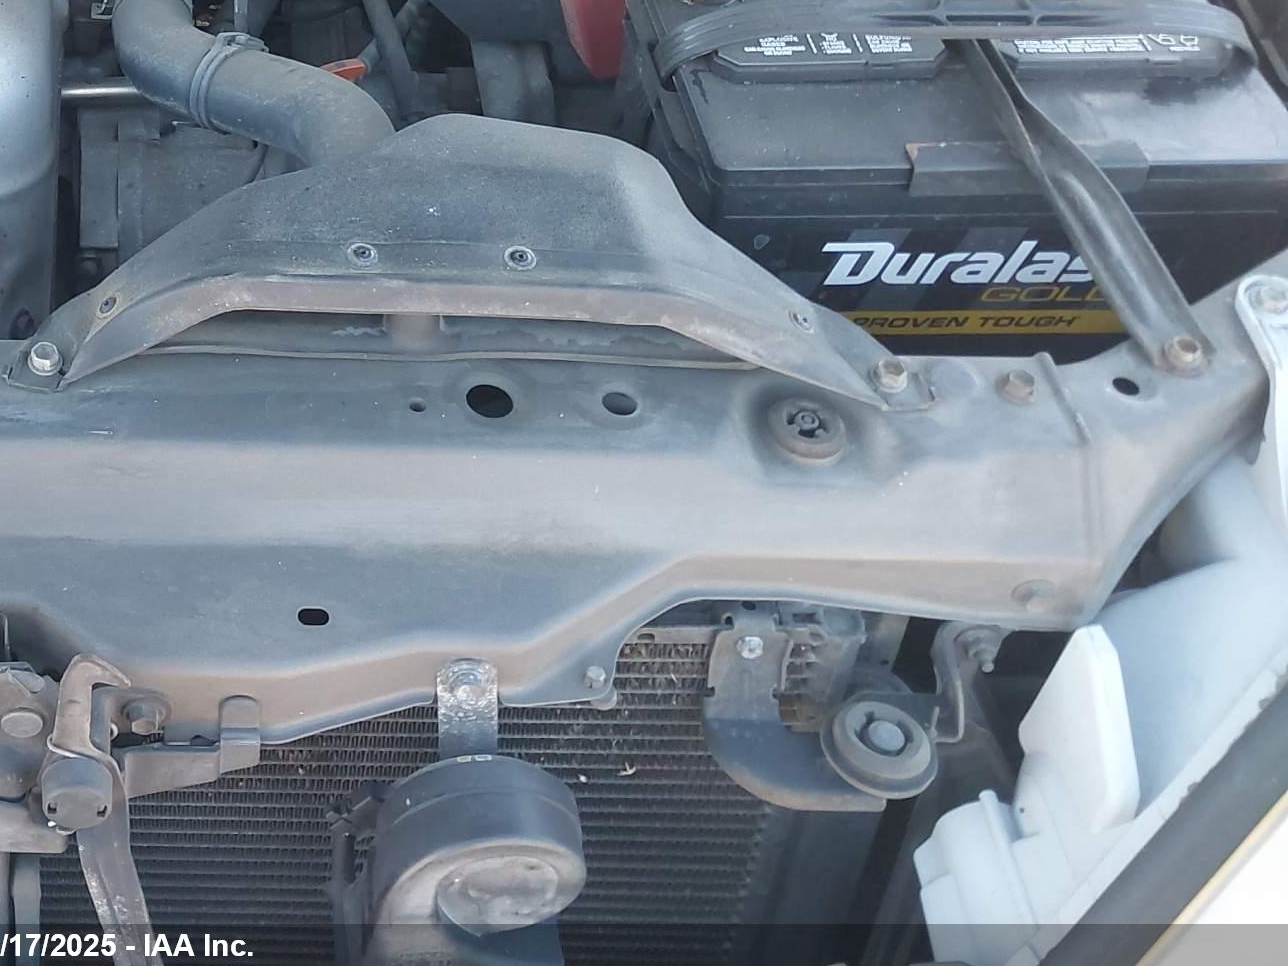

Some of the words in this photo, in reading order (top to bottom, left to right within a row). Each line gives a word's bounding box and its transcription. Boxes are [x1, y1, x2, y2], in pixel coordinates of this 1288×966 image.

[821, 240, 1095, 286] Duralas
[852, 316, 970, 329] PROVEN
[978, 315, 1077, 328] TOUGH
